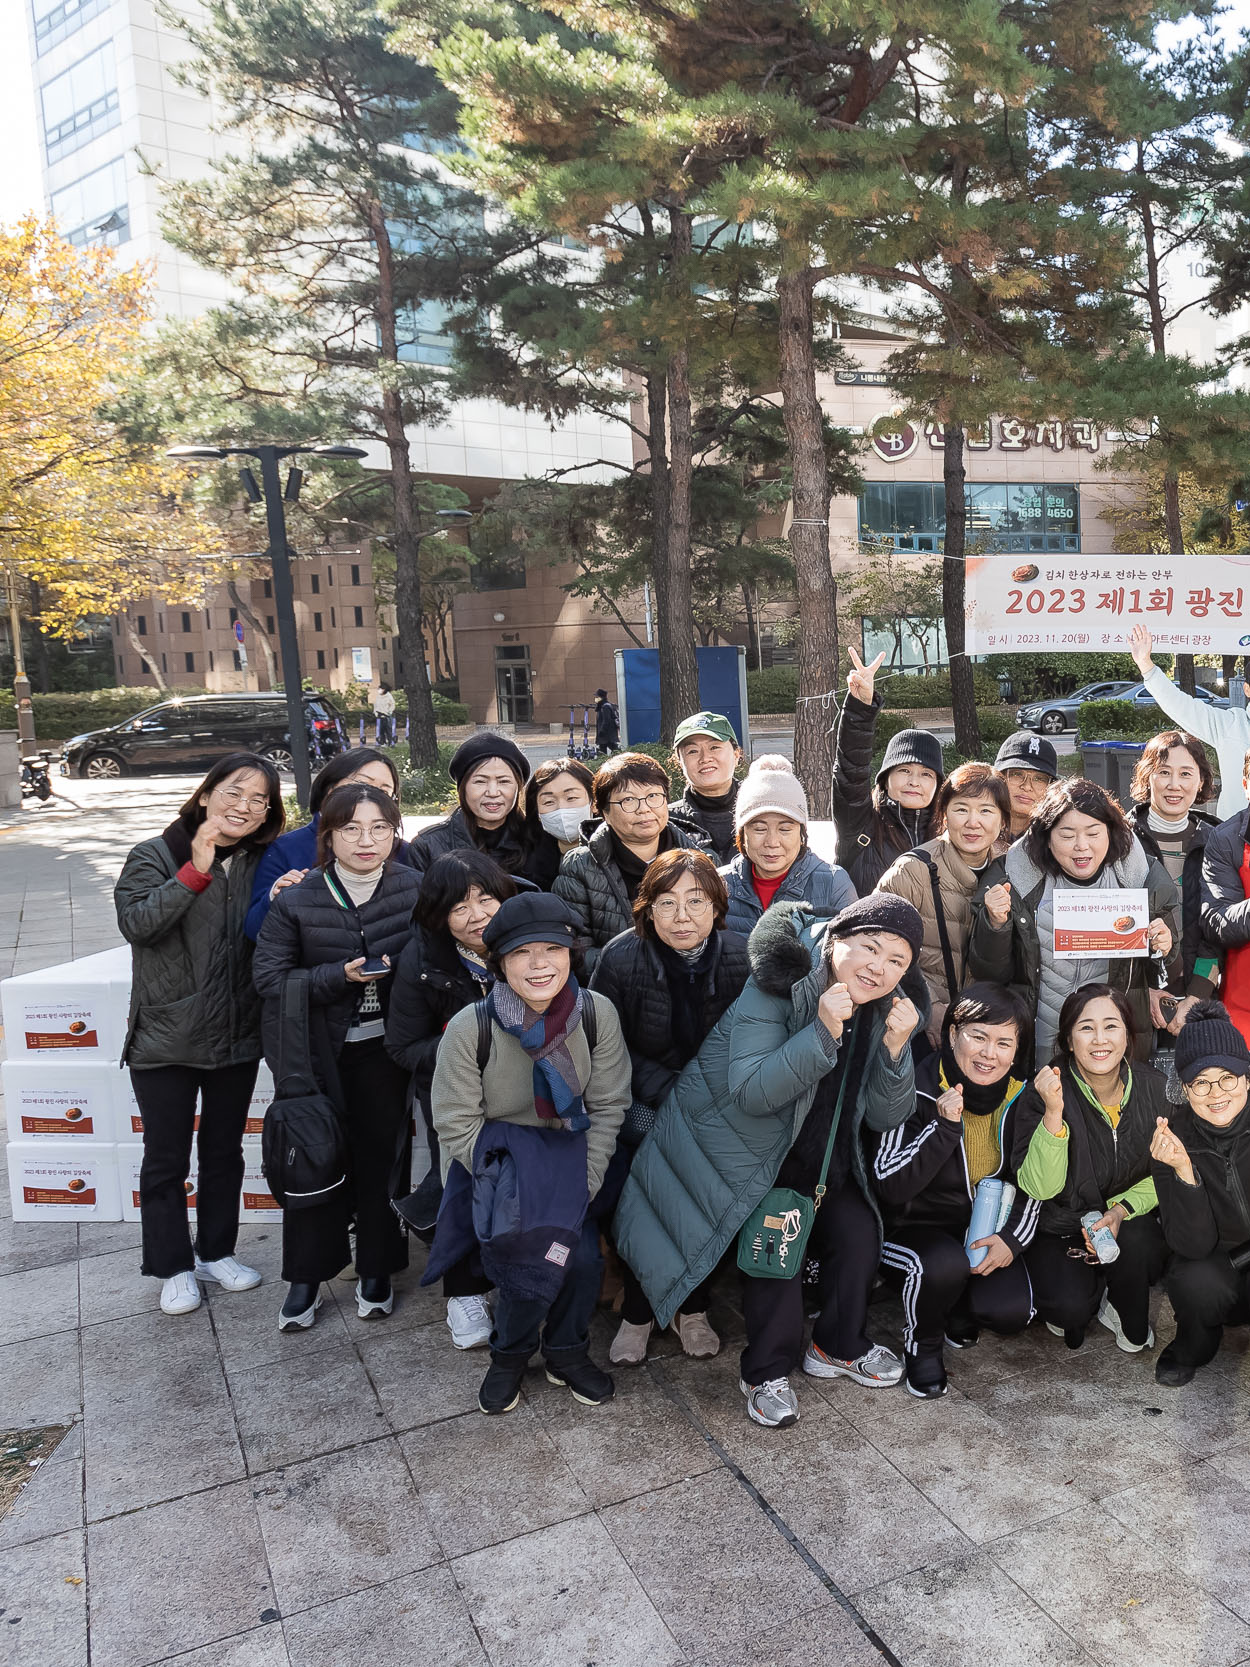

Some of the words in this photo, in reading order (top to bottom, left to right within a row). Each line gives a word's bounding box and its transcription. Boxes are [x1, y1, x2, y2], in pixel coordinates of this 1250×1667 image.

[1046, 508, 1074, 518] 4650
[1045, 570, 1065, 580] 김치
[1068, 570, 1112, 580] 한상자로
[1116, 570, 1148, 580] 전하는
[1152, 570, 1173, 580] 안부
[1005, 588, 1086, 614] 2023
[1095, 586, 1174, 616] 제1회
[1185, 587, 1243, 618] 광진
[988, 635, 996, 646] 일
[999, 634, 1008, 644] 시
[1016, 634, 1042, 644] 2023.
[1046, 634, 1058, 643] 11.
[1061, 634, 1090, 644] 20(월)
[1101, 634, 1110, 644] 장
[1114, 634, 1123, 643] 소
[1192, 635, 1212, 646] 광장
